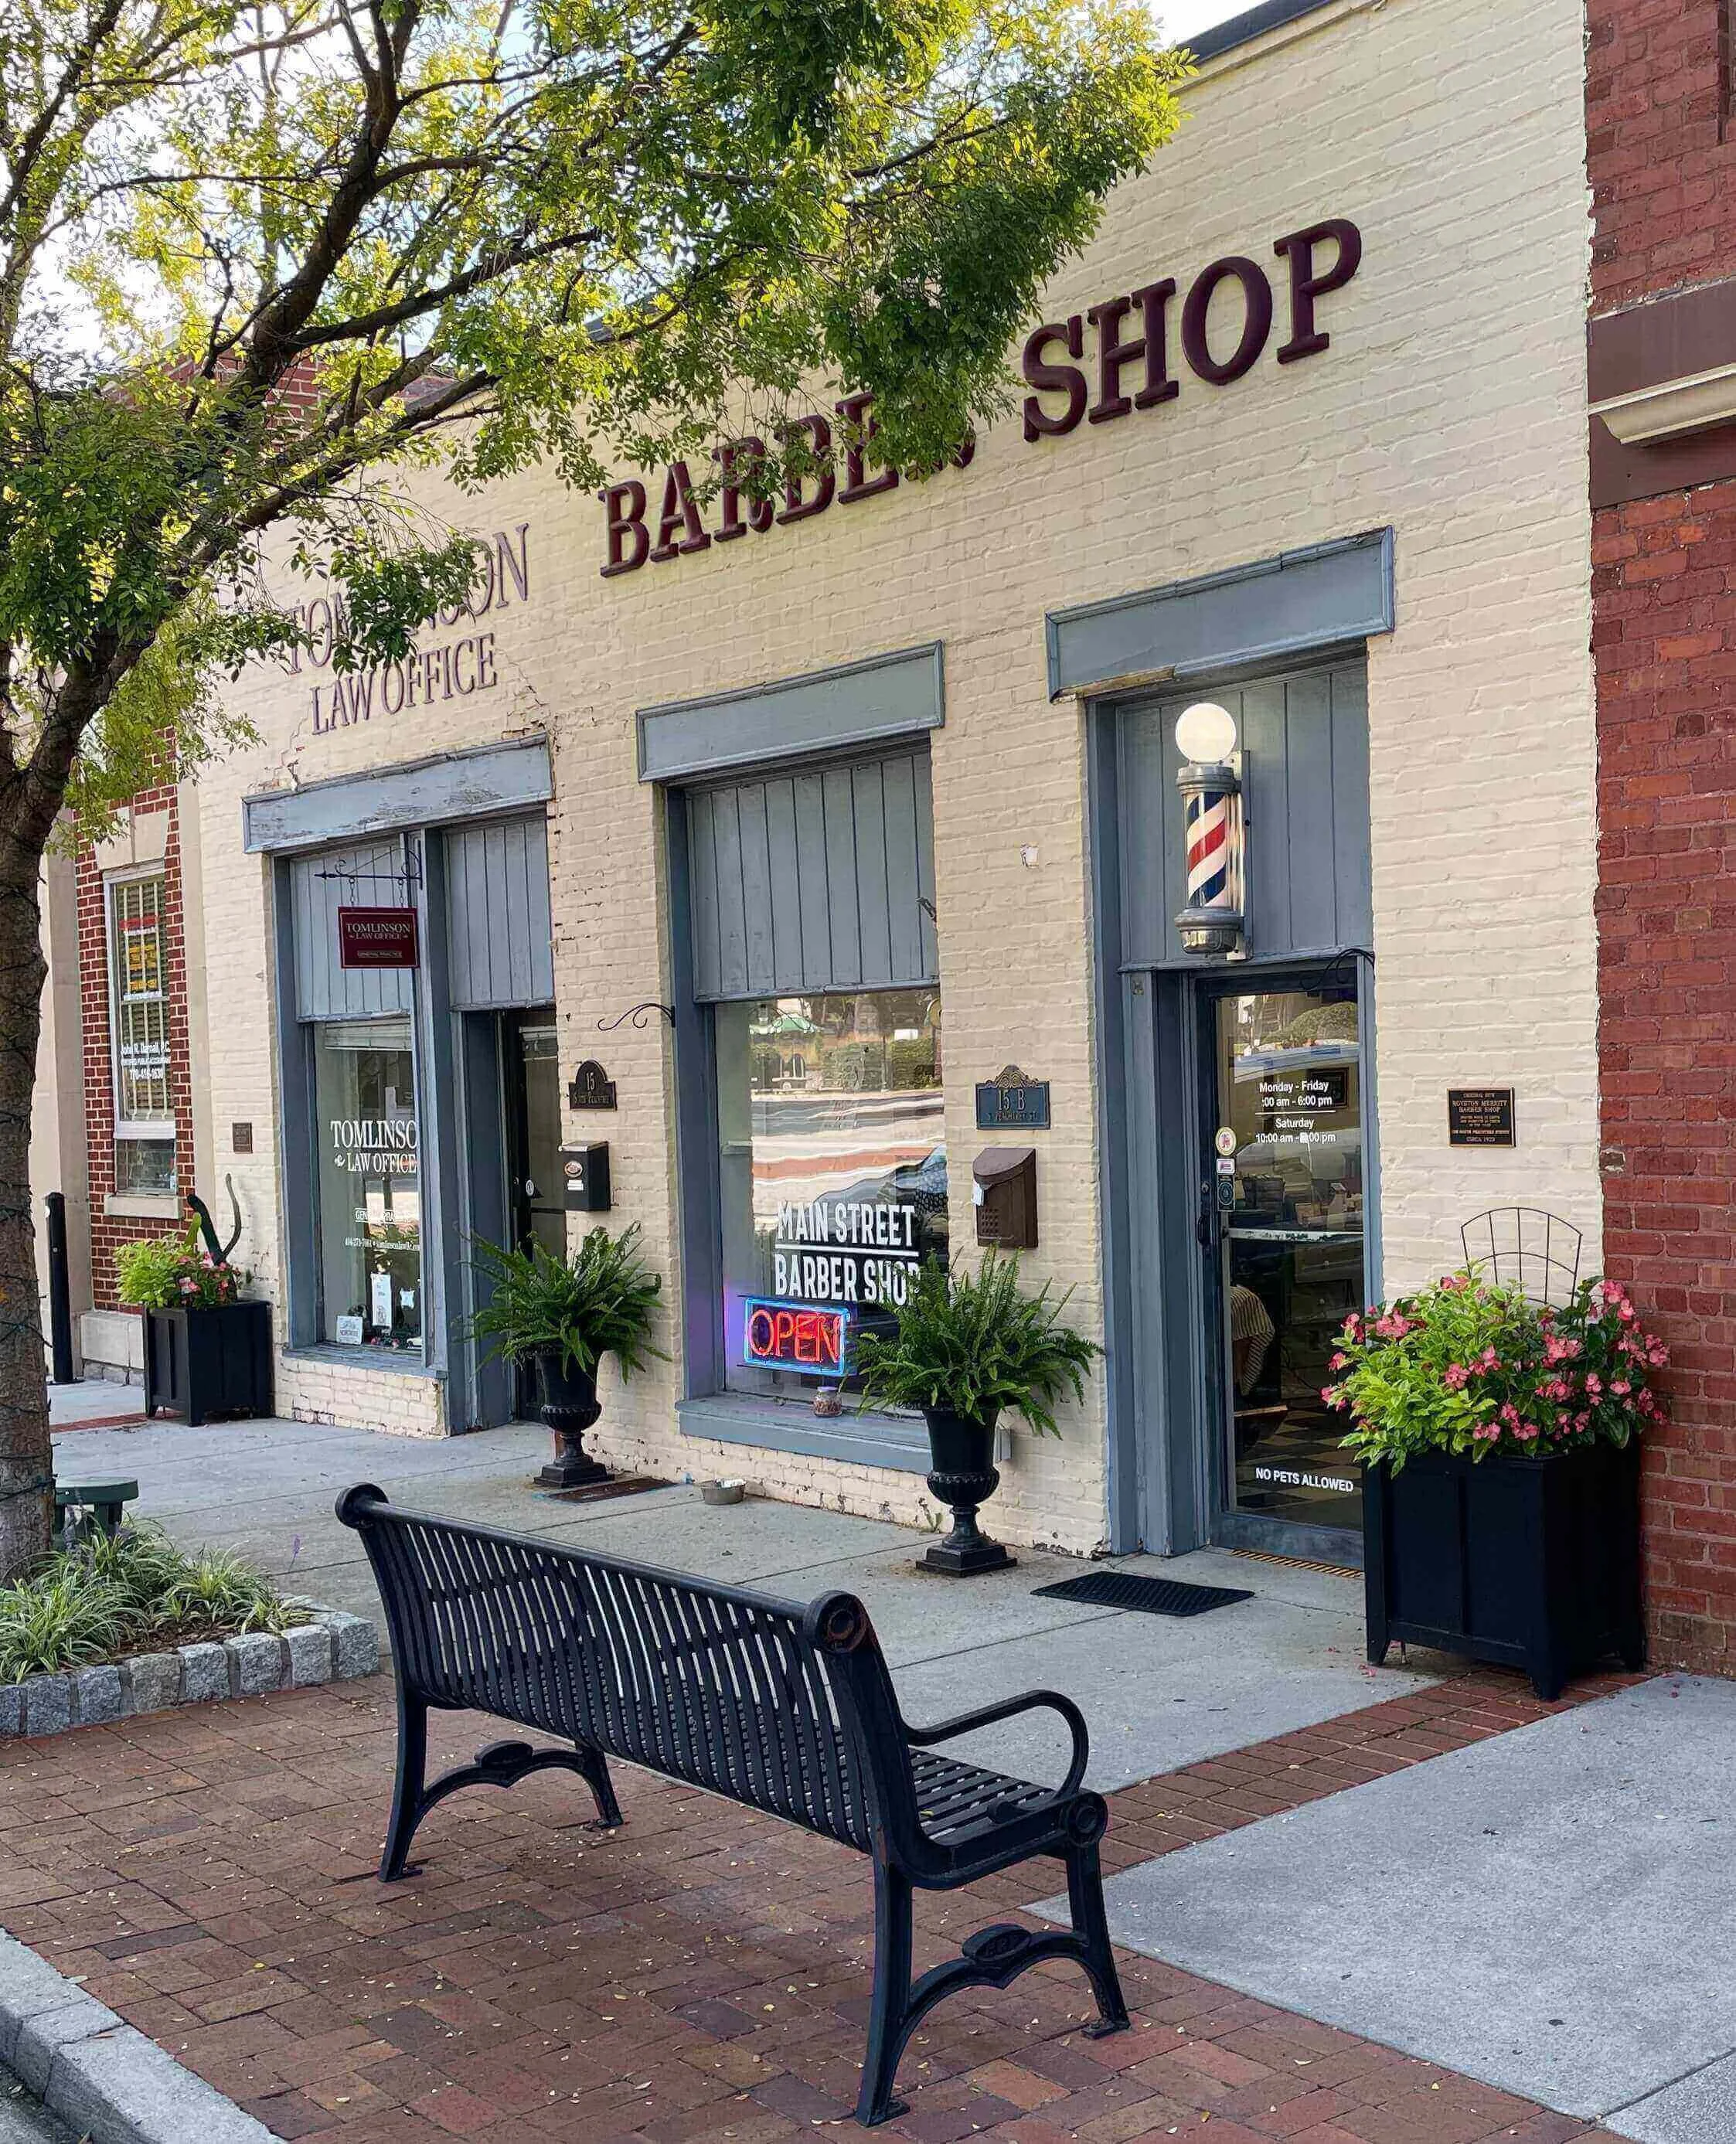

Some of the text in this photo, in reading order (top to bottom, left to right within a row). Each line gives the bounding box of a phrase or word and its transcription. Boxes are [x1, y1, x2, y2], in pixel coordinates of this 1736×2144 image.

[599, 218, 1363, 578] BARBE SHOP
[309, 632, 498, 735] LAW OFFICE
[346, 923, 410, 933] TOMLINSON
[587, 1072, 595, 1090] 15
[1259, 1081, 1293, 1094] Monday
[1302, 1080, 1329, 1092] Friday
[998, 1088, 1026, 1111] 15 B
[1276, 1098, 1290, 1106] am
[1318, 1096, 1333, 1107] pm
[1275, 1118, 1315, 1129] Saturday
[1255, 1133, 1278, 1143] 10:00
[1279, 1135, 1293, 1143] am
[1322, 1133, 1336, 1144] pm
[346, 1152, 417, 1173] LAW OFFICE
[778, 1201, 915, 1247] MAIN STREET
[774, 1253, 858, 1302] BARBER
[748, 1309, 841, 1363] OPEN
[1255, 1467, 1354, 1492] NO PETS ALLOWED
